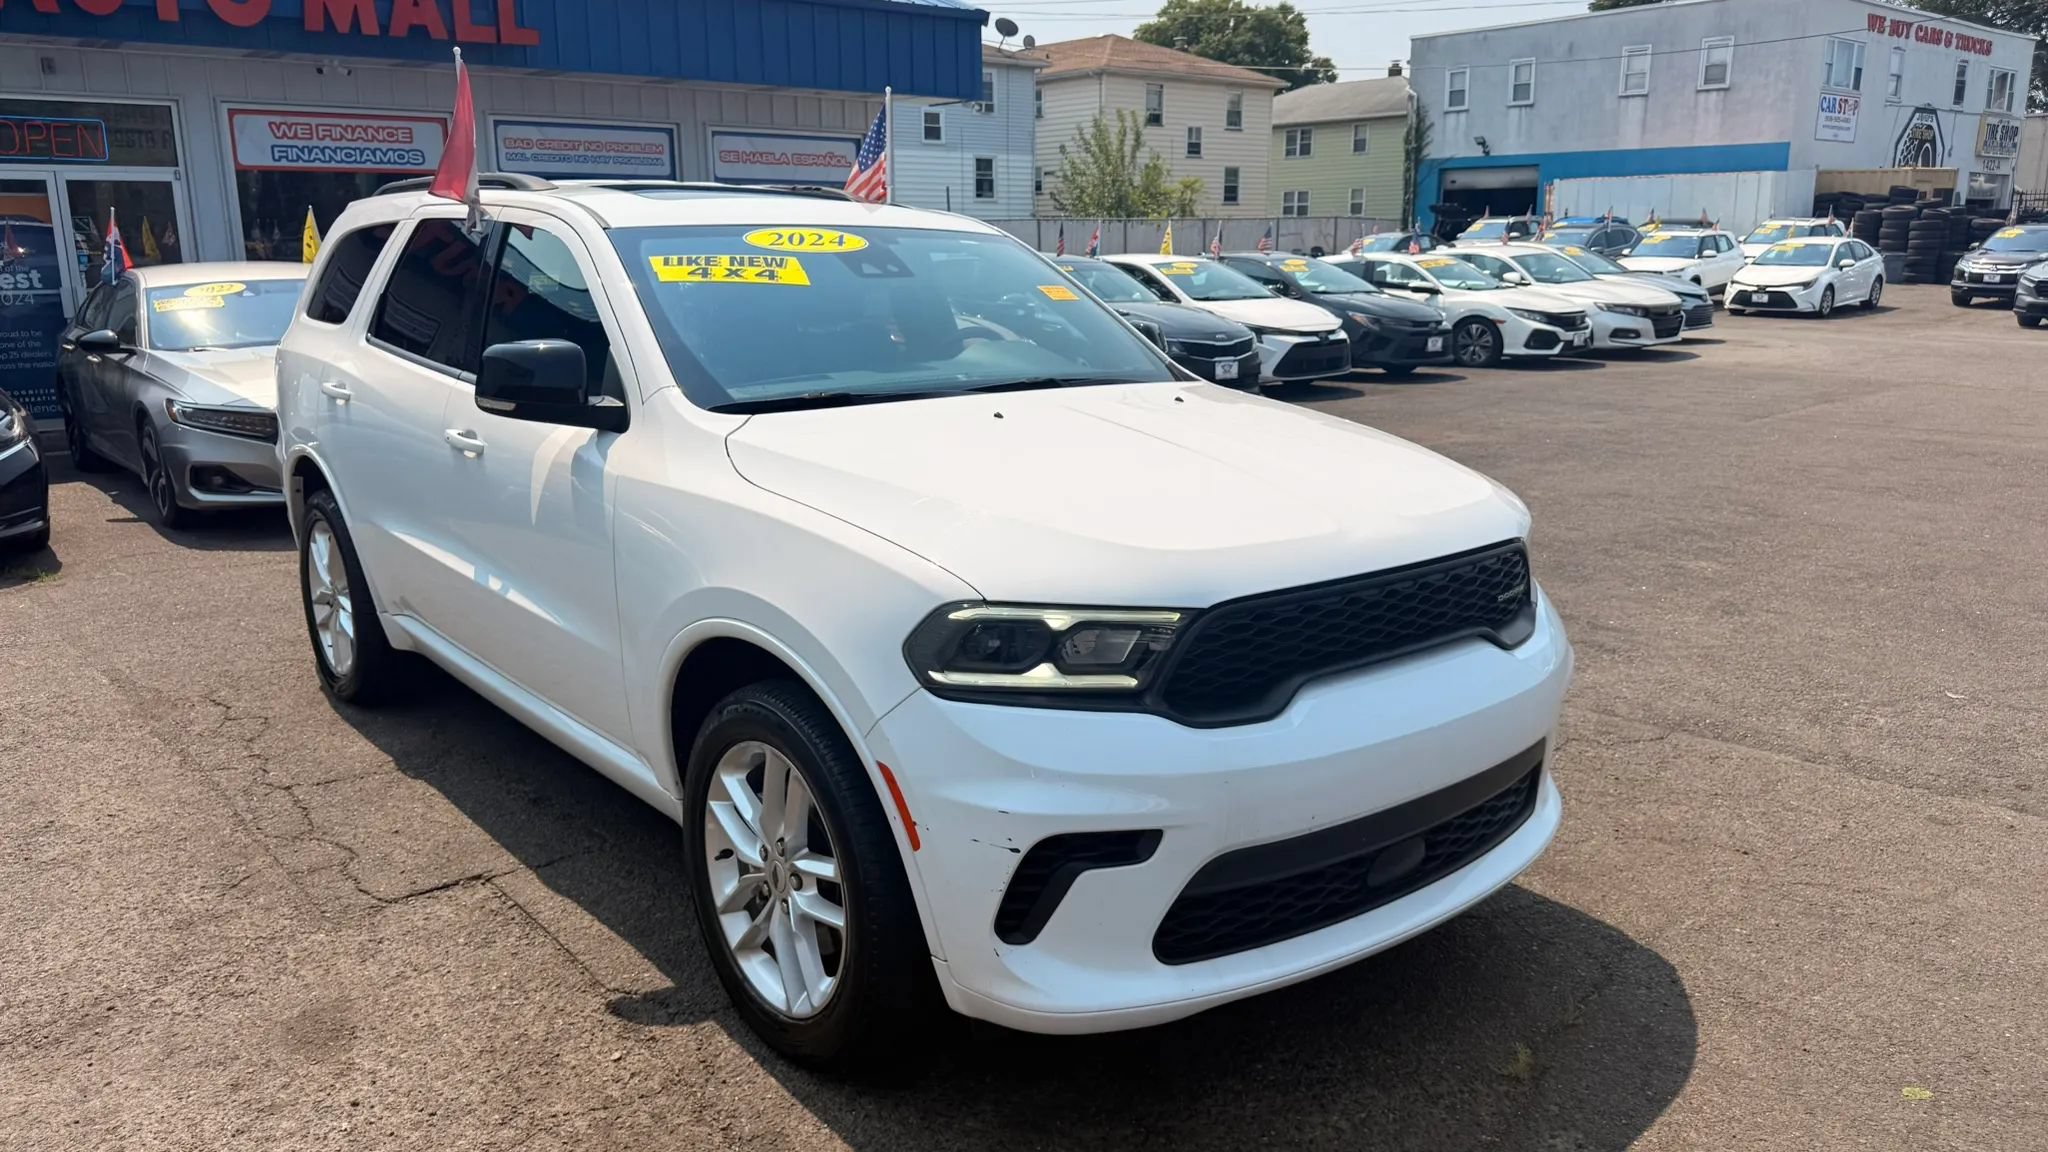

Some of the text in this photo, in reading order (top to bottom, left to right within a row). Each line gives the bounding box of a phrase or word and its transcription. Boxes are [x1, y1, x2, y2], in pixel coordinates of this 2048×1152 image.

[1868, 13, 1993, 57] WE BUY CARS & TRUCKS
[1821, 96, 1837, 113] CAR
[0, 119, 105, 158] OPEN
[268, 120, 413, 144] WE FINANCE
[1985, 123, 2019, 142] TIRE SHOP
[504, 137, 664, 155] BAD CREDIT NO PROBLEM
[271, 145, 425, 166] FINANCIAMOS
[505, 152, 529, 162] MAL
[719, 150, 851, 168] SE HABLA ESPAÑOL
[768, 232, 846, 247] 2024
[662, 256, 788, 269] LIKE NEW
